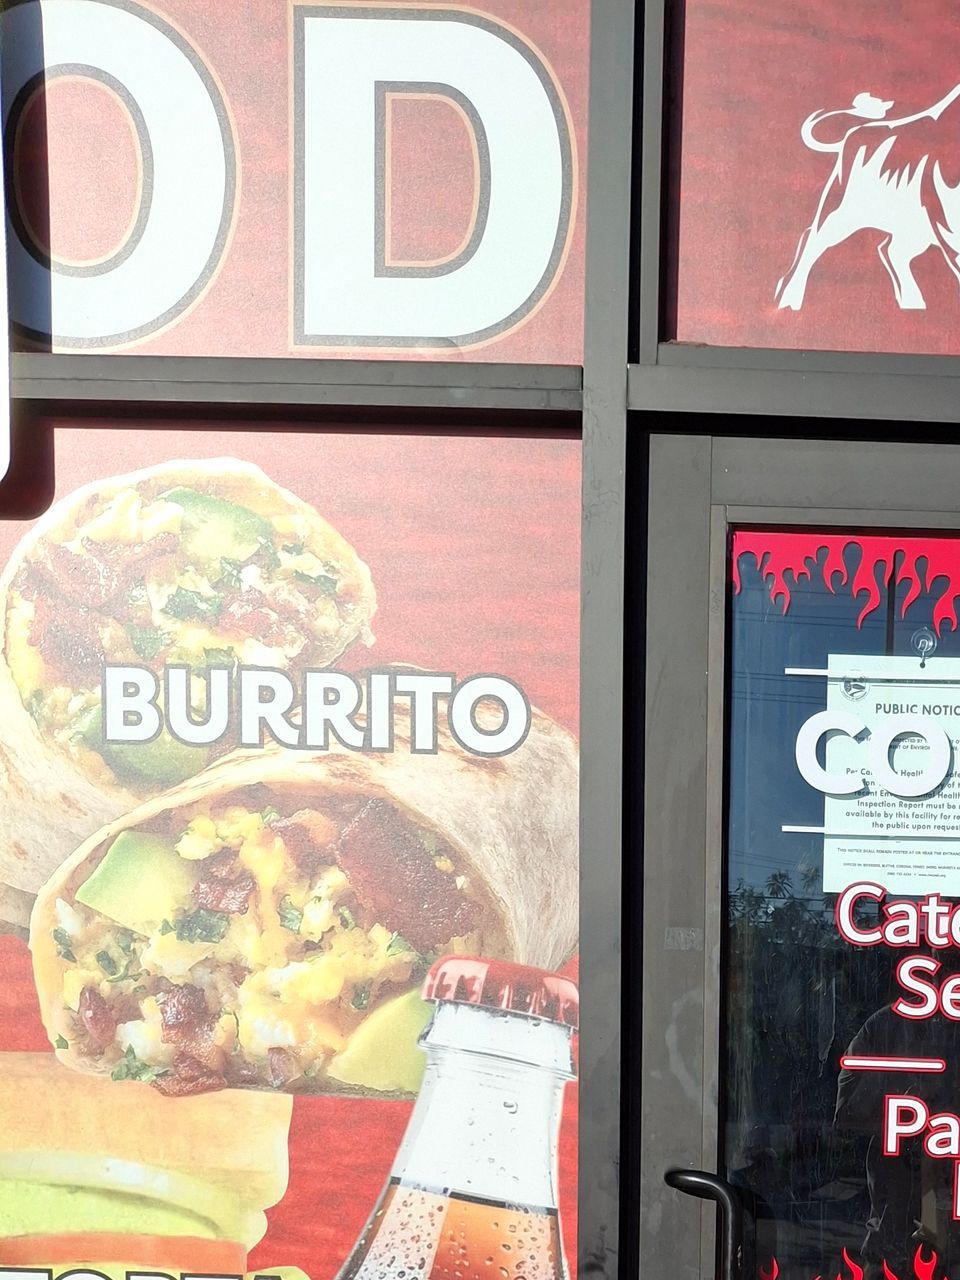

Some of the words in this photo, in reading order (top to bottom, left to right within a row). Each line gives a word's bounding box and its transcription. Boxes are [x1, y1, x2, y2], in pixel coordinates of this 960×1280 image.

[102, 665, 532, 758] BURRITO
[875, 703, 918, 714] PUBLIC
[857, 800, 896, 810] Inspection
[898, 801, 924, 810] Report
[926, 802, 944, 810] must
[946, 802, 957, 810] be
[845, 810, 882, 818] available
[883, 811, 894, 820] by
[912, 812, 938, 820] facility
[886, 822, 910, 830] public
